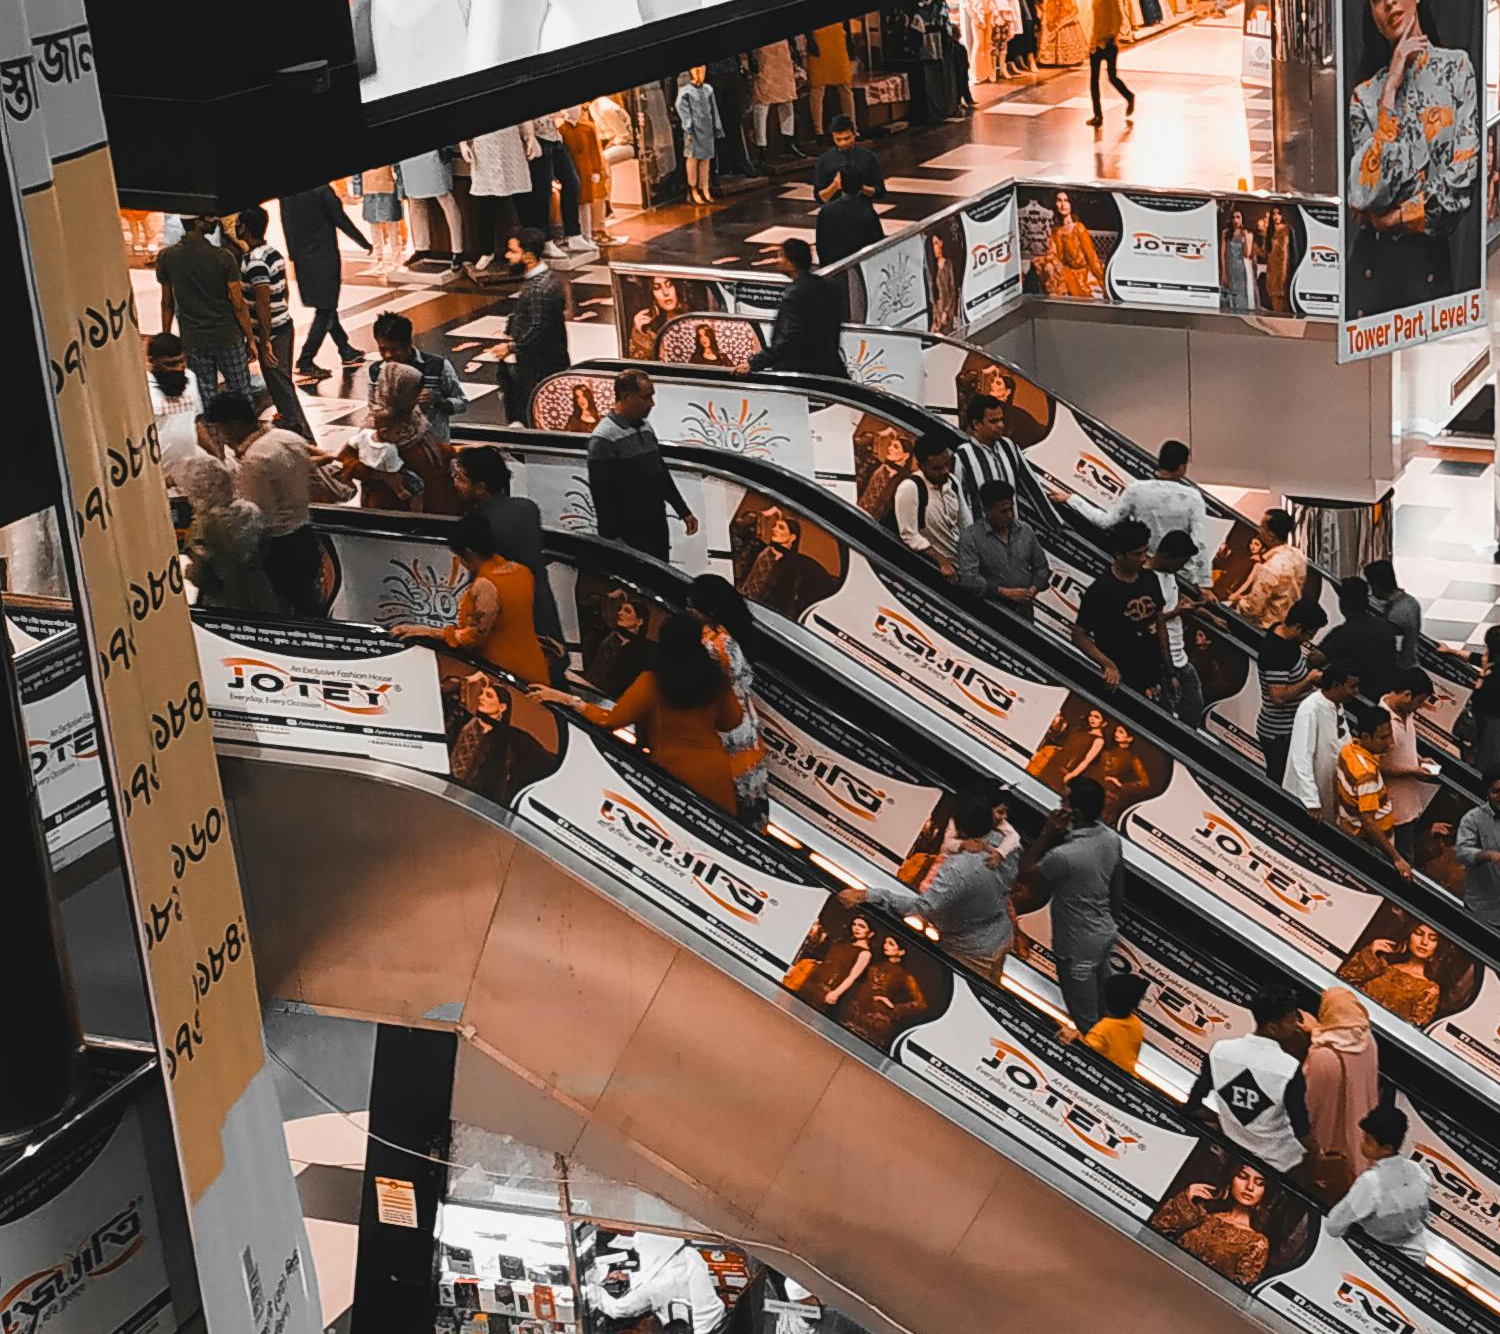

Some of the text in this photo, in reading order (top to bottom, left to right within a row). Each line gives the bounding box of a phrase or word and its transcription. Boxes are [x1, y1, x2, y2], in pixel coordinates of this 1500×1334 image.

[1133, 237, 1207, 255] JOTEY
[1347, 294, 1480, 355] Tower Part, Level 5
[227, 666, 393, 706] JOTEY
[265, 696, 286, 706] Every
[286, 698, 322, 709] Occasion
[290, 665, 392, 683] An Exclusive Fashion House
[1195, 822, 1327, 906] JOTEY
[976, 1065, 1060, 1123] Everyday, Every Occasion
[980, 1049, 1138, 1149] JOTEY
[1051, 1077, 1144, 1139] An Exclusive Fashion House
